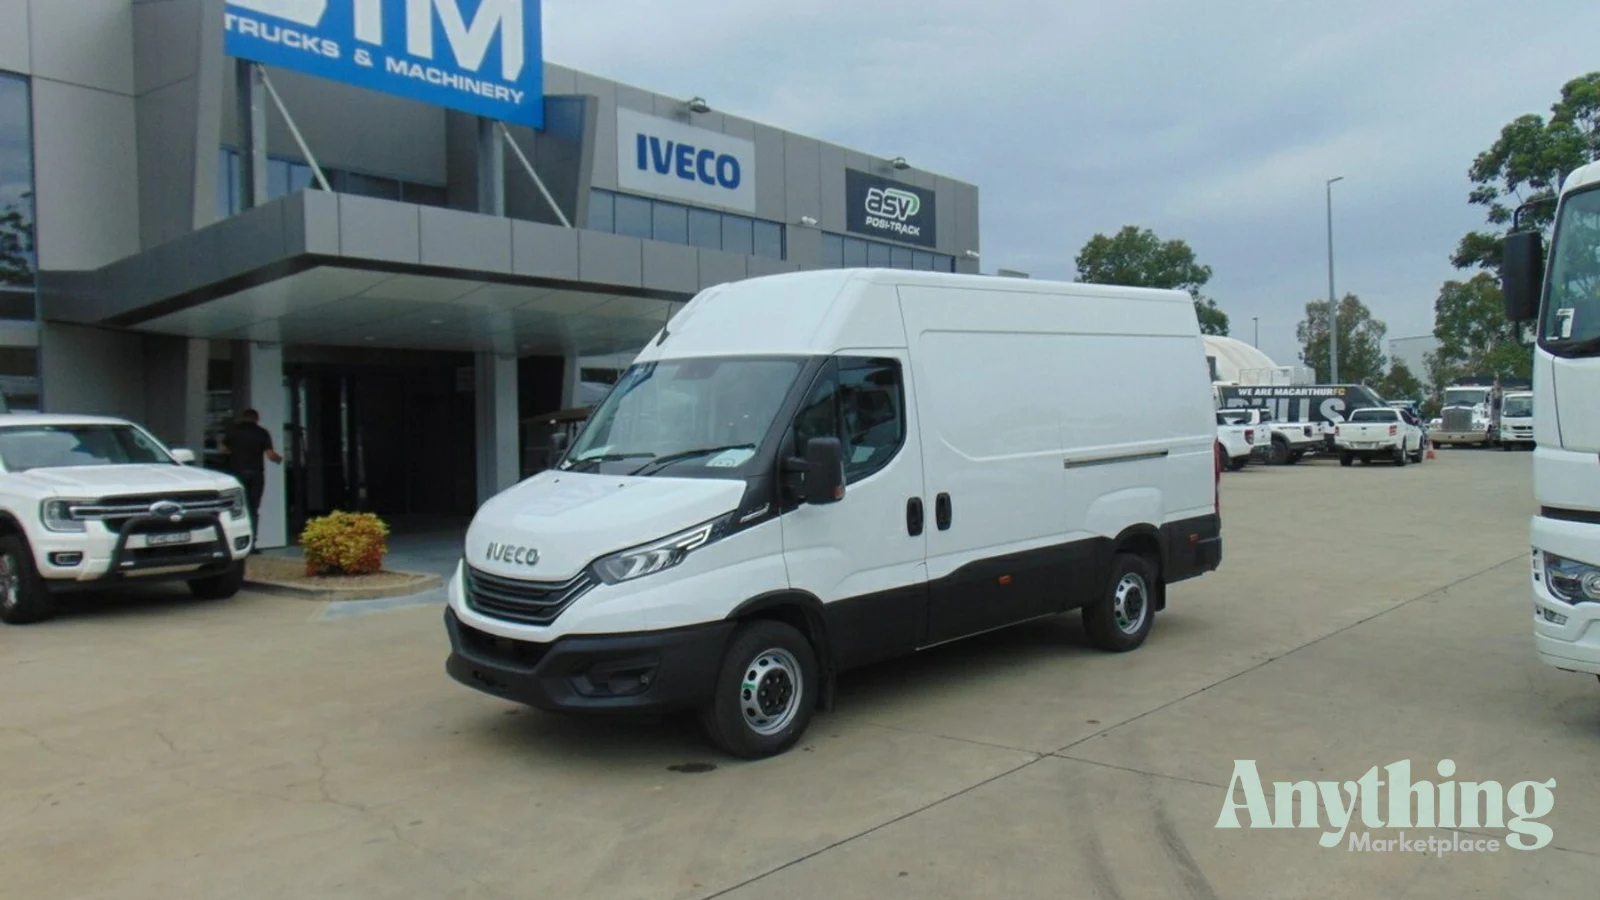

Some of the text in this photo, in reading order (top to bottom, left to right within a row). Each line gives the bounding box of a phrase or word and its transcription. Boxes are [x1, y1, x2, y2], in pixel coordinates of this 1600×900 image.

[354, 48, 374, 67] &
[385, 57, 525, 105] MACHINERY
[637, 132, 741, 190] IVECO
[865, 216, 920, 236] POSI-TRACK
[1238, 388, 1252, 396] WE
[1254, 388, 1272, 396] ARE
[486, 542, 540, 566] IVECO
